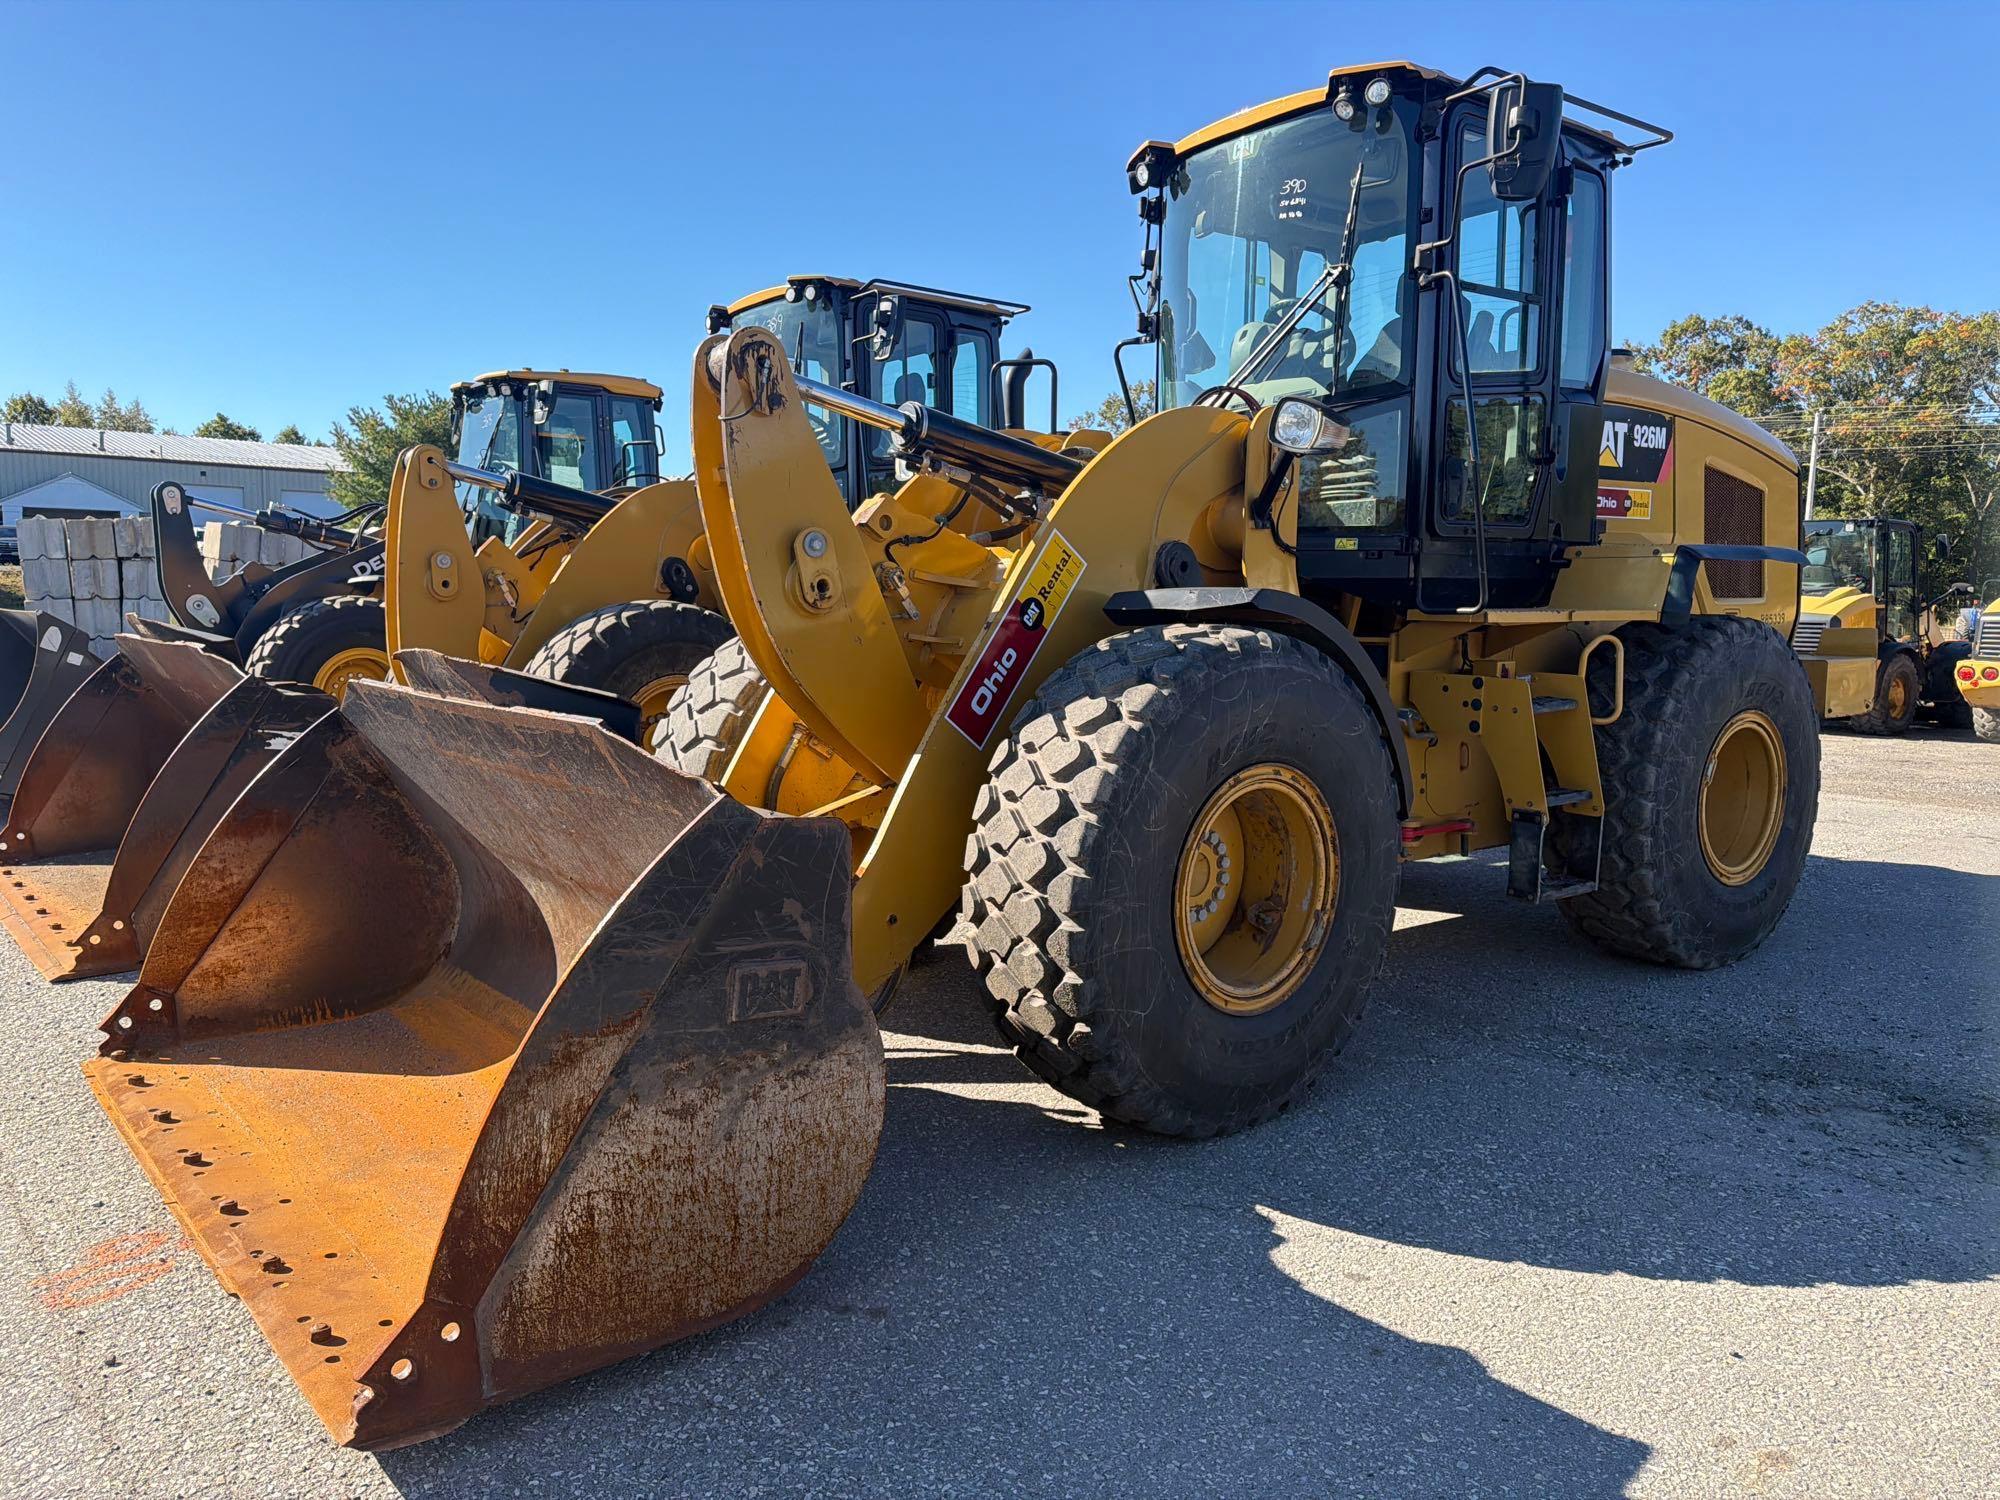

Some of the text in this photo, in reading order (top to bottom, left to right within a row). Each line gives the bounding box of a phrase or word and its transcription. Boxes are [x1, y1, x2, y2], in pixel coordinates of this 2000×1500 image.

[1280, 178, 1307, 195] 390
[1600, 420, 1667, 468] AT 926M
[1023, 549, 1072, 627] CAT Rental
[970, 647, 1017, 716] Ohio
